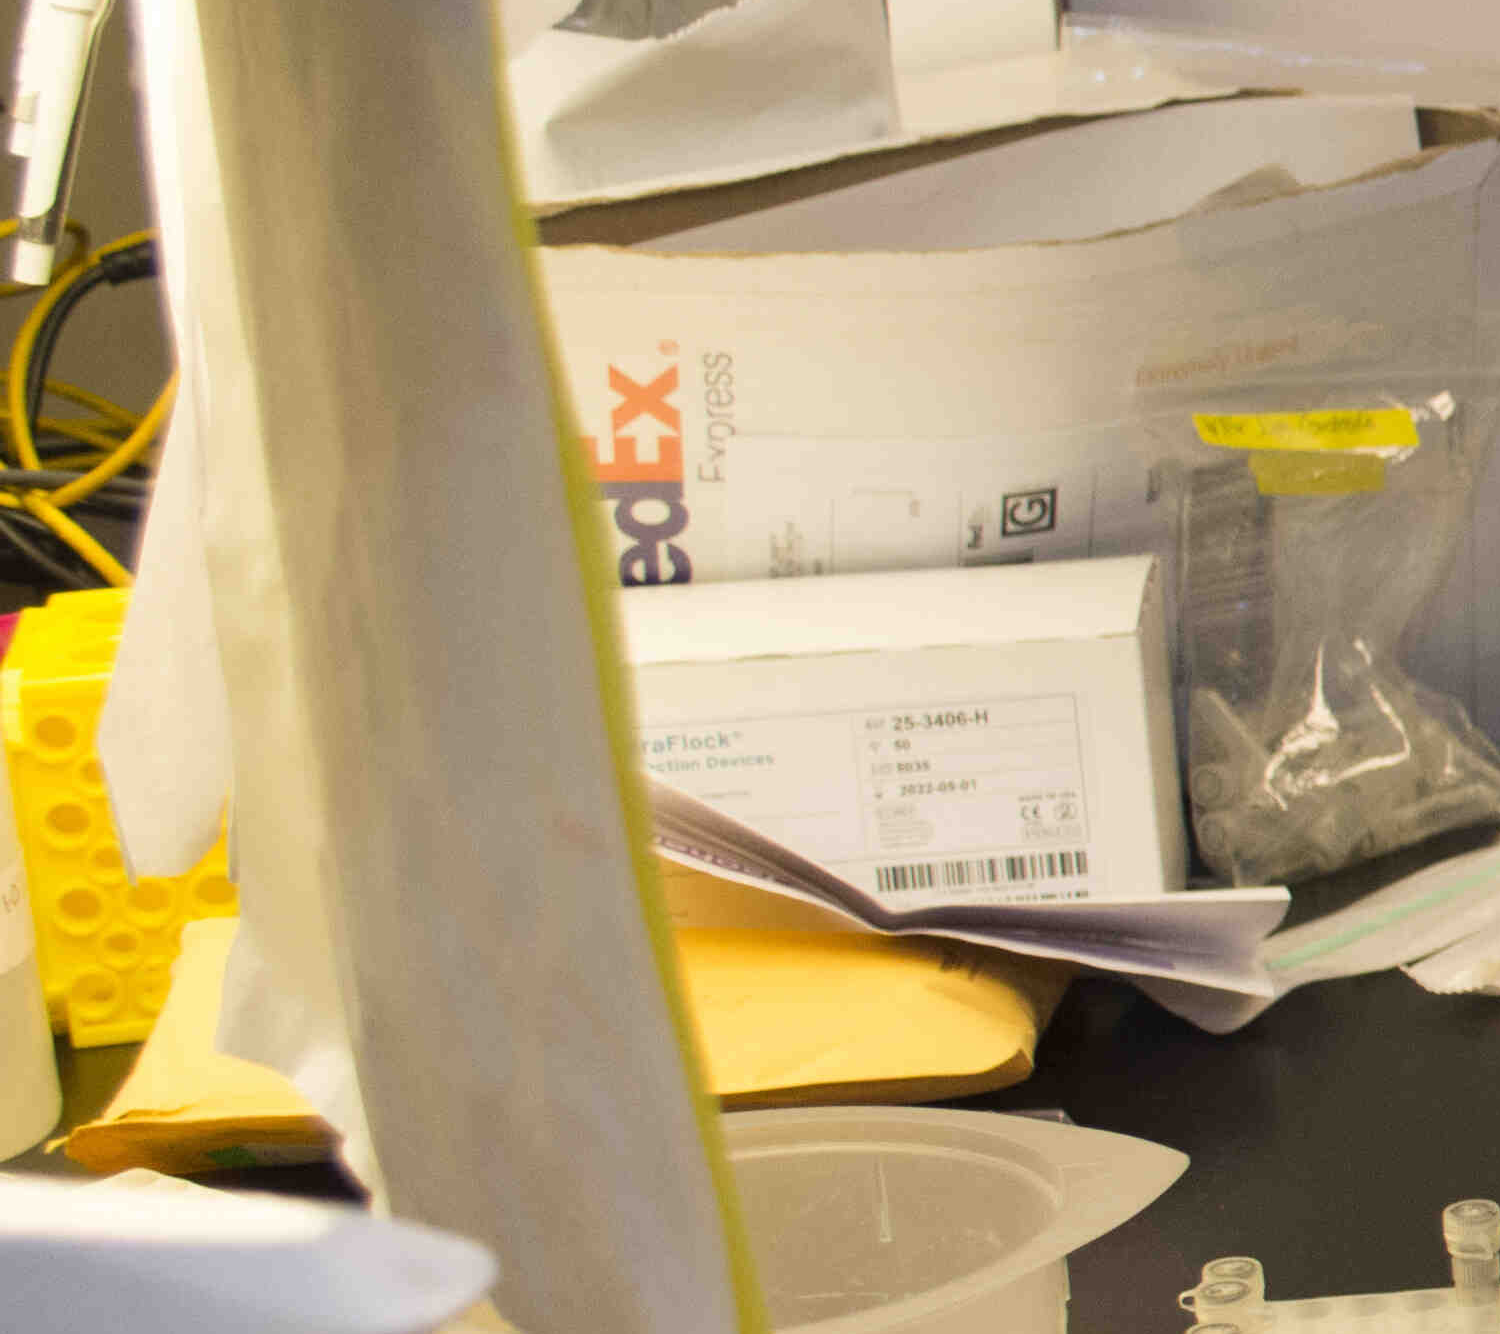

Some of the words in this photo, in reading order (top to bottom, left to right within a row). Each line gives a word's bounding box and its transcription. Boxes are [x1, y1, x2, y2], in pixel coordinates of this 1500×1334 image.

[580, 363, 692, 587] edEx
[1008, 497, 1048, 528] G
[640, 729, 732, 755] raFlock
